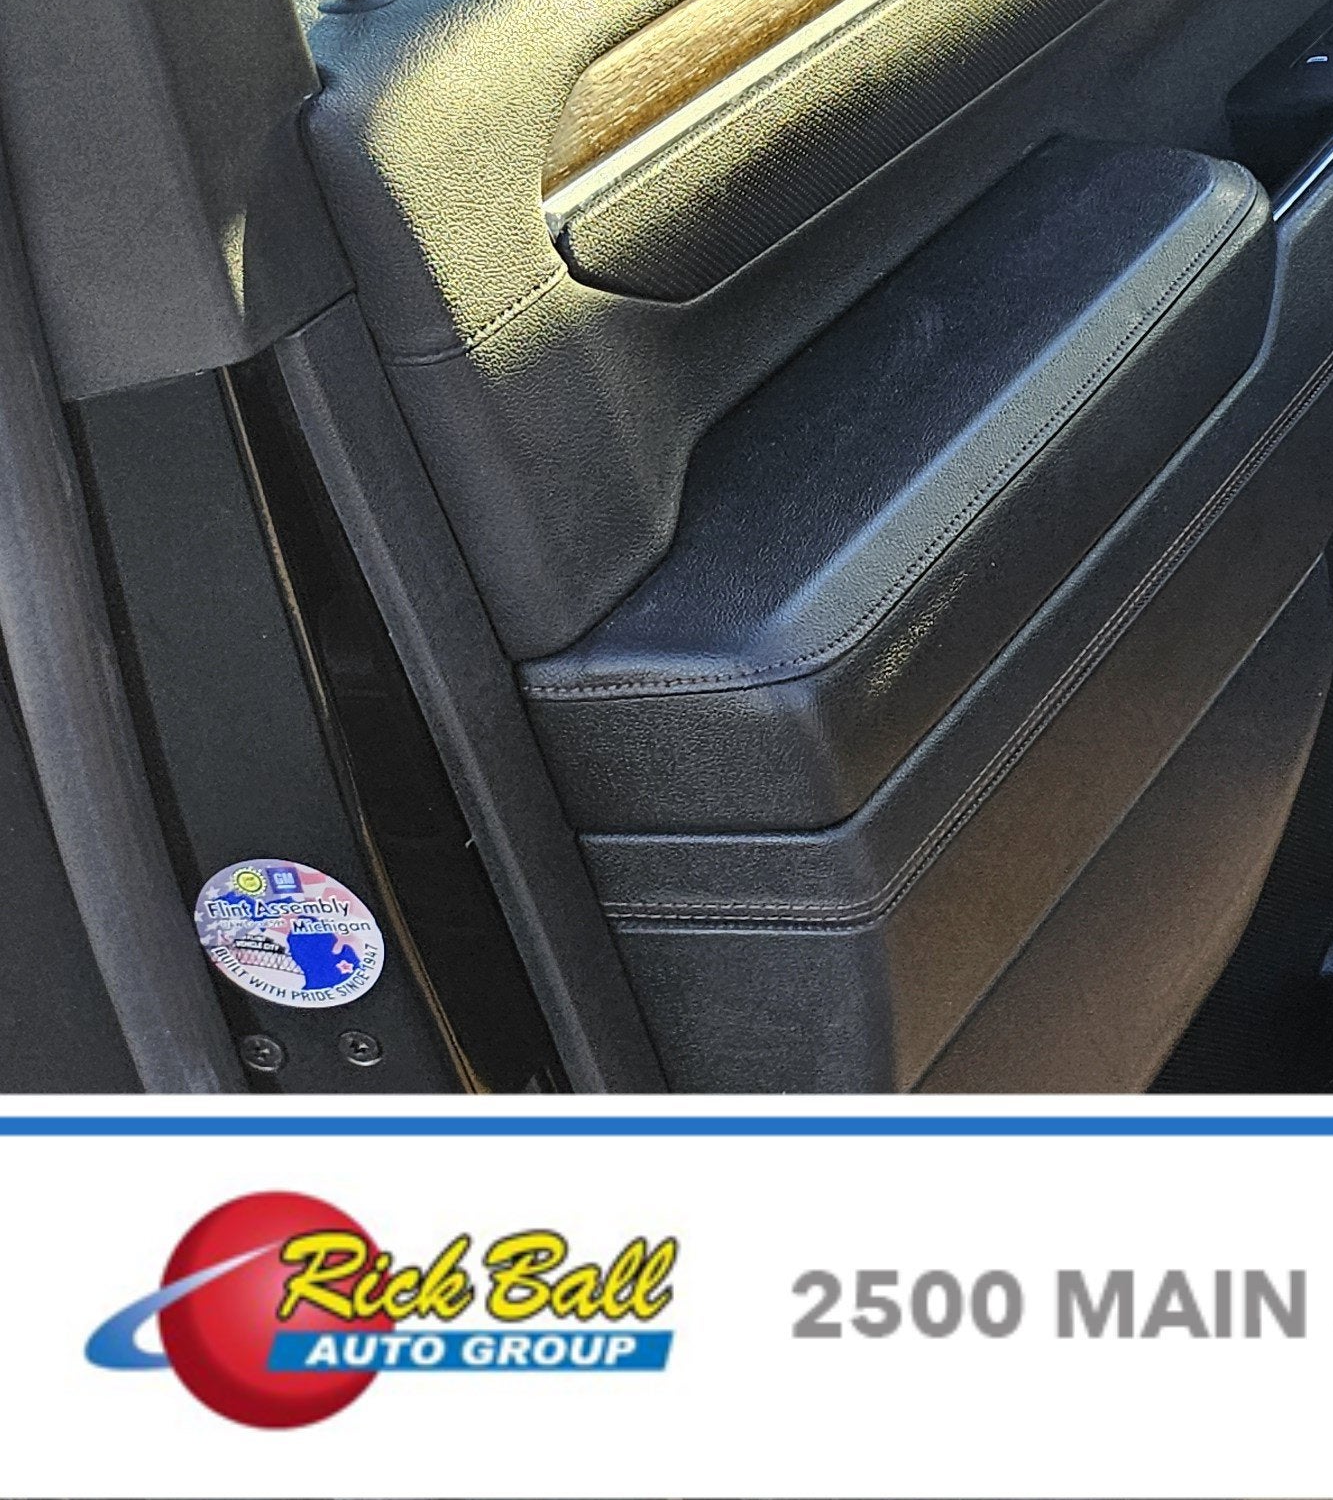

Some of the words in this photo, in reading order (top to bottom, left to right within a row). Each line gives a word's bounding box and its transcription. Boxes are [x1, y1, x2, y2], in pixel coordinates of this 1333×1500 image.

[207, 901, 252, 918] Flint
[255, 897, 350, 918] Assembly
[292, 918, 372, 935] Michigan
[213, 946, 249, 978] BUILT
[249, 974, 287, 998] WITH
[291, 988, 336, 1002] PRIDE
[335, 968, 371, 997] SINCE
[362, 943, 379, 973] 1947
